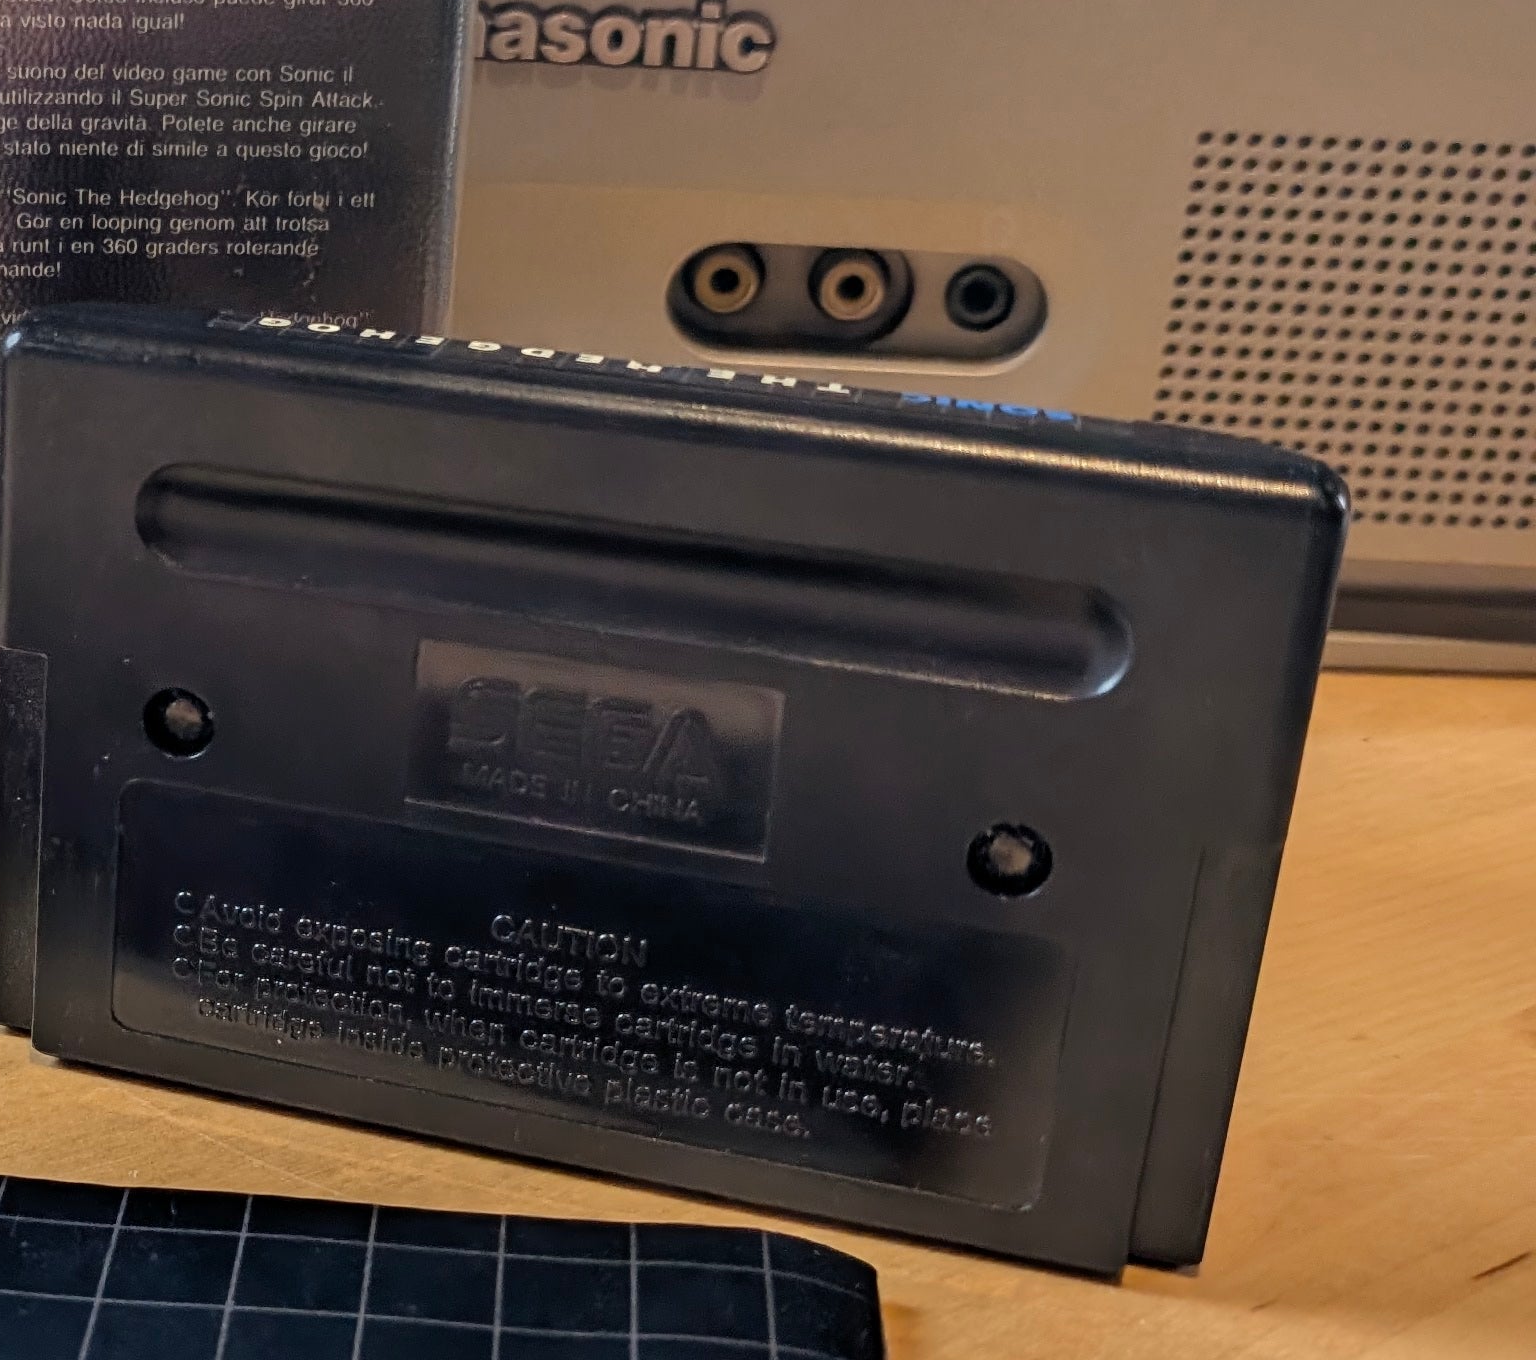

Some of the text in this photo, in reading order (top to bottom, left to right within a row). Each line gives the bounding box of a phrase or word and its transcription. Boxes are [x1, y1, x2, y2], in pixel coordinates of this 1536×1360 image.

[258, 317, 663, 374] HEDGEHOG
[706, 367, 851, 395] THE
[462, 763, 547, 800] MADE
[607, 788, 704, 825] CHINA
[202, 894, 285, 932] Avoid
[296, 916, 431, 967] exposing
[445, 946, 582, 991] cartridge
[596, 970, 625, 997] to
[641, 983, 771, 1027] extreme
[491, 914, 648, 968] CAUTION
[198, 959, 244, 992] For
[257, 977, 414, 1029] protection,
[424, 1006, 505, 1046] when
[520, 1029, 658, 1076] cartridge
[674, 1052, 698, 1082] is
[714, 1066, 767, 1096] not
[822, 1086, 889, 1125] use,
[901, 1098, 993, 1138] place
[200, 926, 238, 959] Be
[252, 943, 353, 983] careful
[368, 964, 416, 993] not
[427, 972, 454, 1001] to
[616, 1013, 758, 1060] cartridge
[815, 1049, 914, 1088] water.
[198, 998, 810, 1138] cartridge inside protective plastic case.
